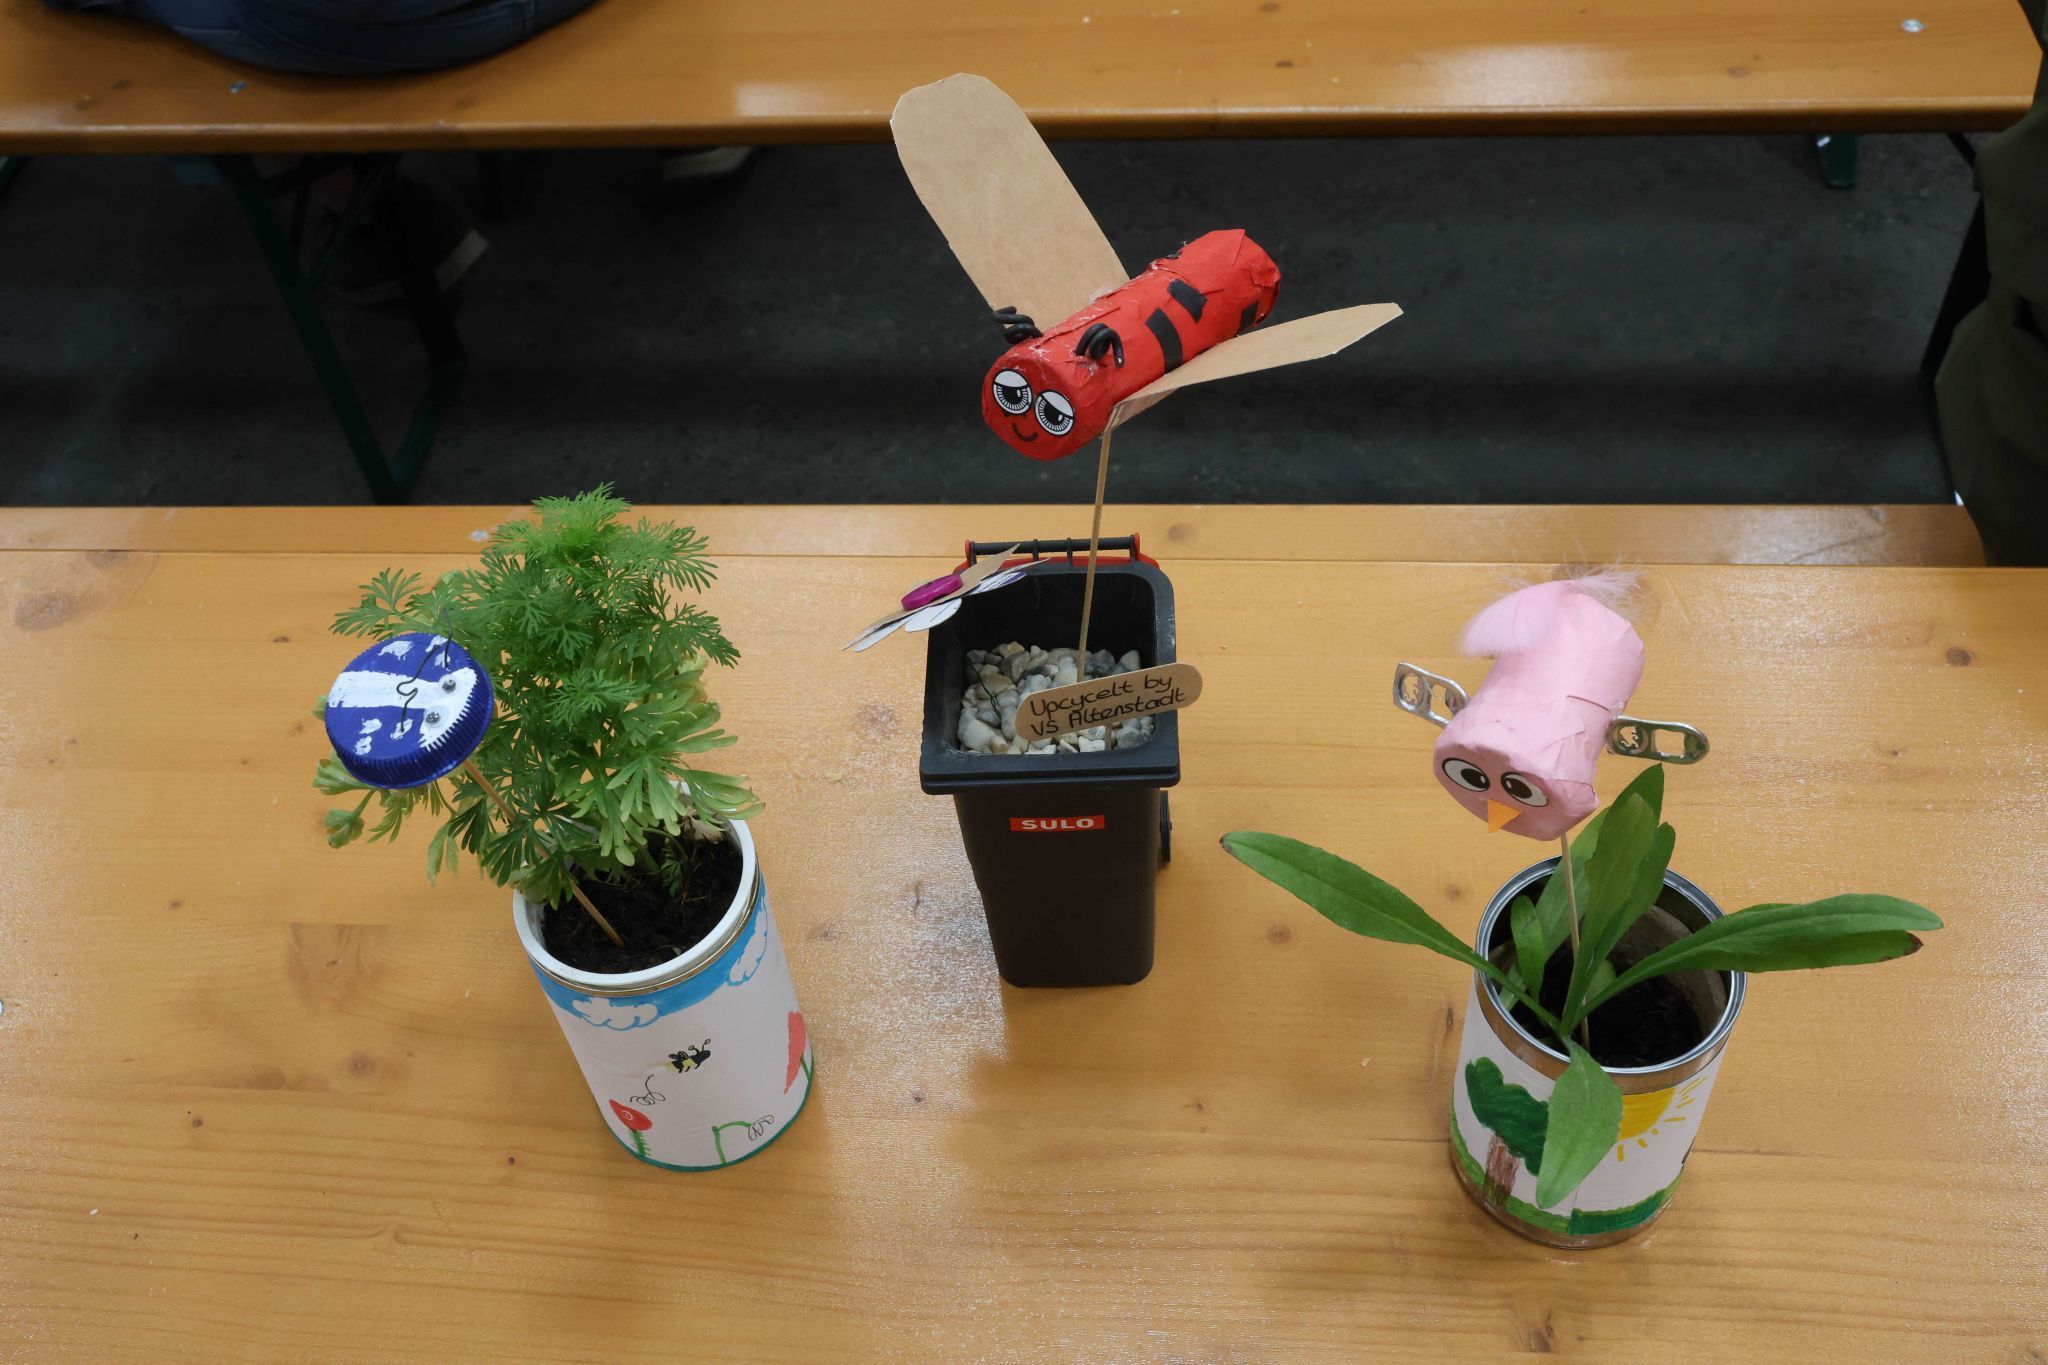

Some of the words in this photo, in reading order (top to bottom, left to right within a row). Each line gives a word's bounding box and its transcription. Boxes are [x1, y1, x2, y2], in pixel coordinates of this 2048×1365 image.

[1030, 680, 1134, 719] Upcycelt
[1143, 674, 1173, 693] by
[1030, 719, 1060, 736] VS
[1068, 687, 1186, 729] Altenstadt
[1021, 818, 1095, 830] SULO
